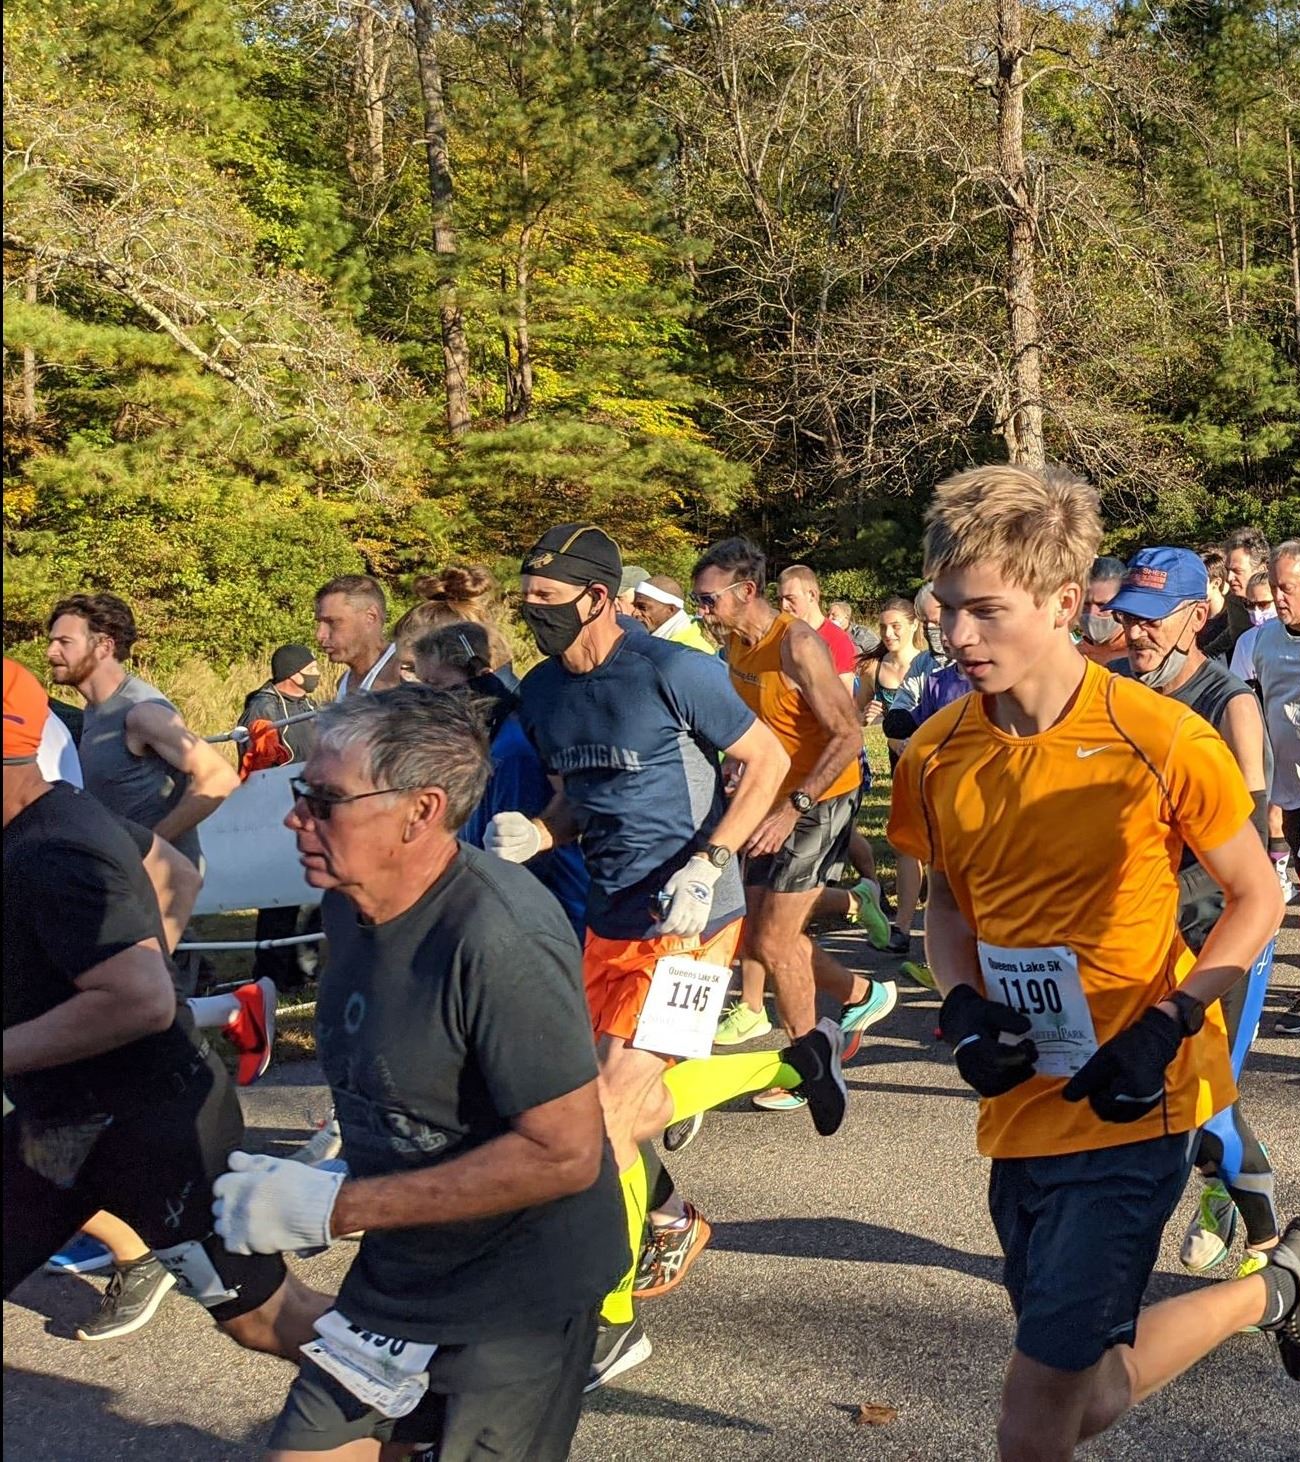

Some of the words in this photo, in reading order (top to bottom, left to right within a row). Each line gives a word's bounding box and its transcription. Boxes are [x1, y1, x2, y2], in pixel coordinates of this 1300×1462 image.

[549, 744, 642, 771] MICHIGAN
[668, 966, 697, 980] Queens
[698, 973, 711, 982] Lake
[711, 975, 721, 983] 5K
[1020, 961, 1045, 973] Lake
[1047, 961, 1063, 972] 5K
[667, 981, 711, 1012] 1145
[999, 977, 1062, 1015] 1190
[1060, 1027, 1088, 1040] PARK
